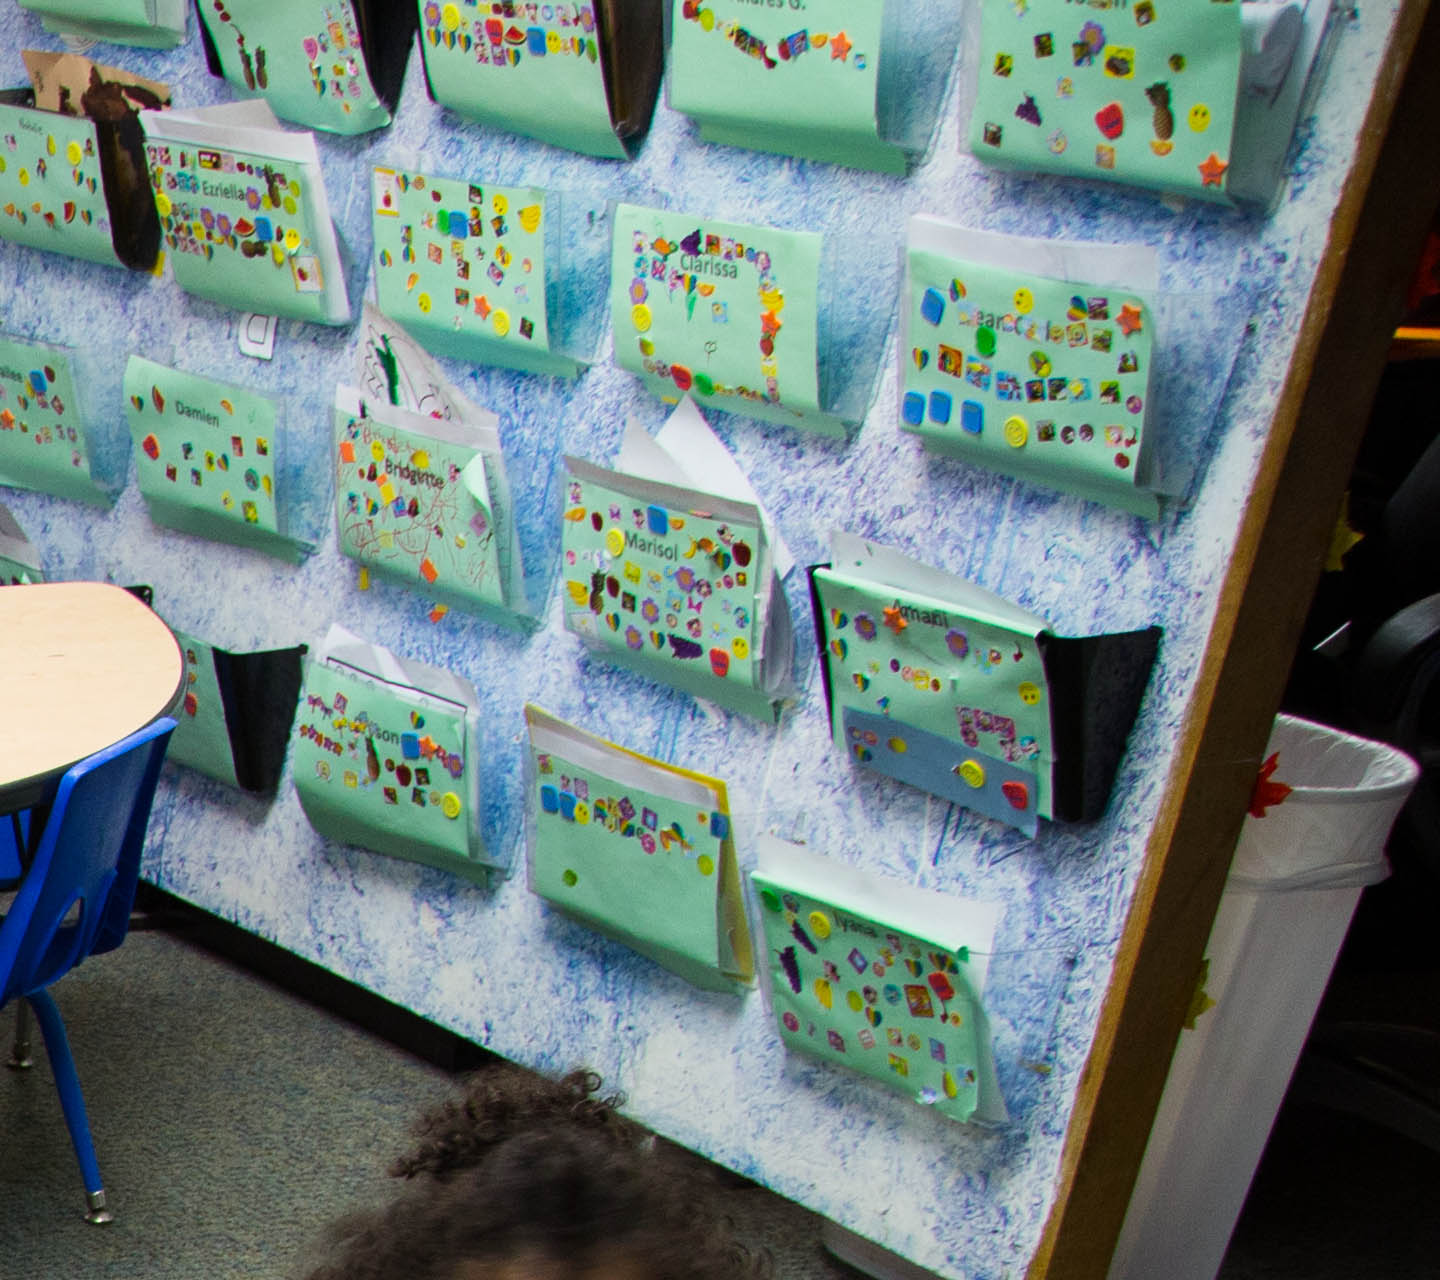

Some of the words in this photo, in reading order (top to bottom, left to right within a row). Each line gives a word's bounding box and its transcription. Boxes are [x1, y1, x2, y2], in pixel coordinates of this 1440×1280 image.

[680, 253, 738, 279] Clarissa
[175, 400, 220, 428] Damien
[624, 531, 678, 562] Marisol
